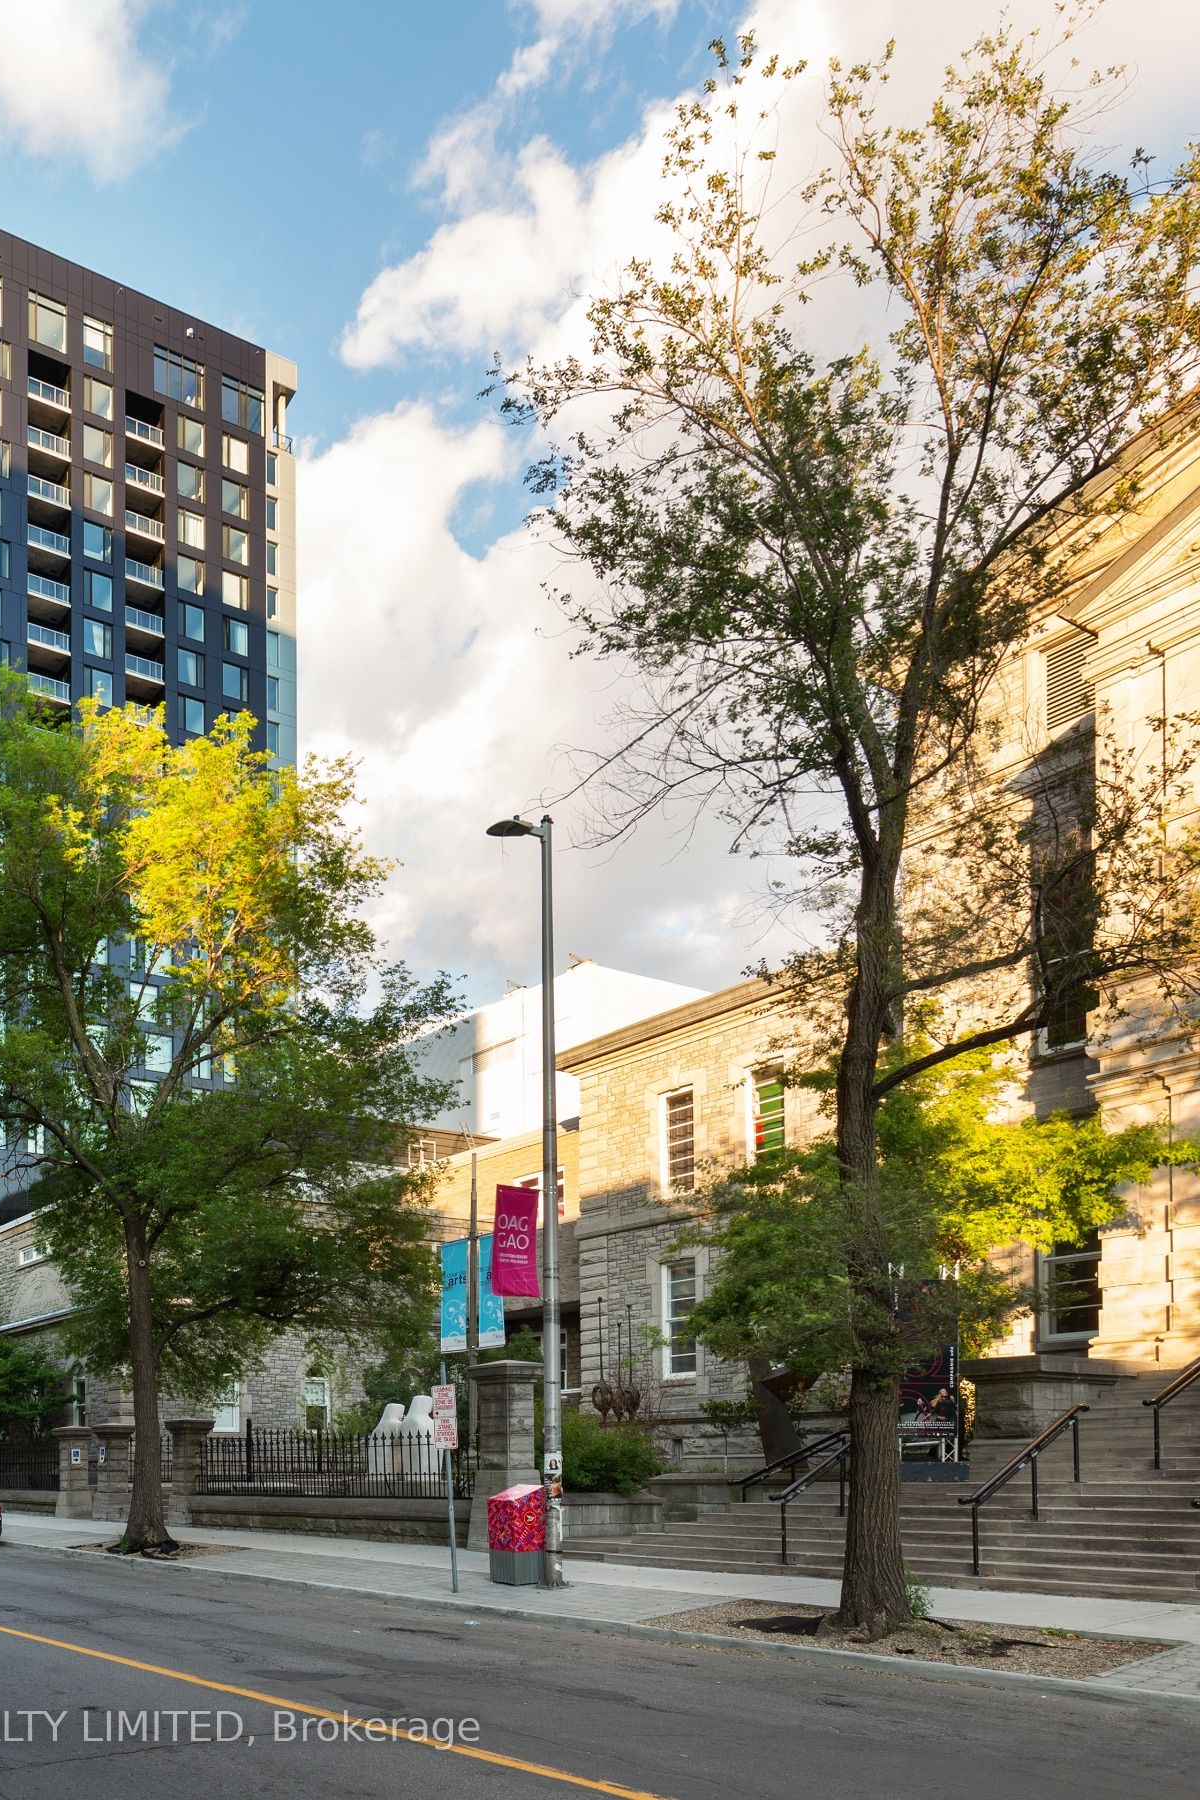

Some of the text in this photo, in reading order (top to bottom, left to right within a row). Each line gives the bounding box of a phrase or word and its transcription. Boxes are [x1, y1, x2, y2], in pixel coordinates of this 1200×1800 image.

[498, 1214, 528, 1232] OAG
[497, 1232, 530, 1250] GAO
[448, 1274, 467, 1286] arts
